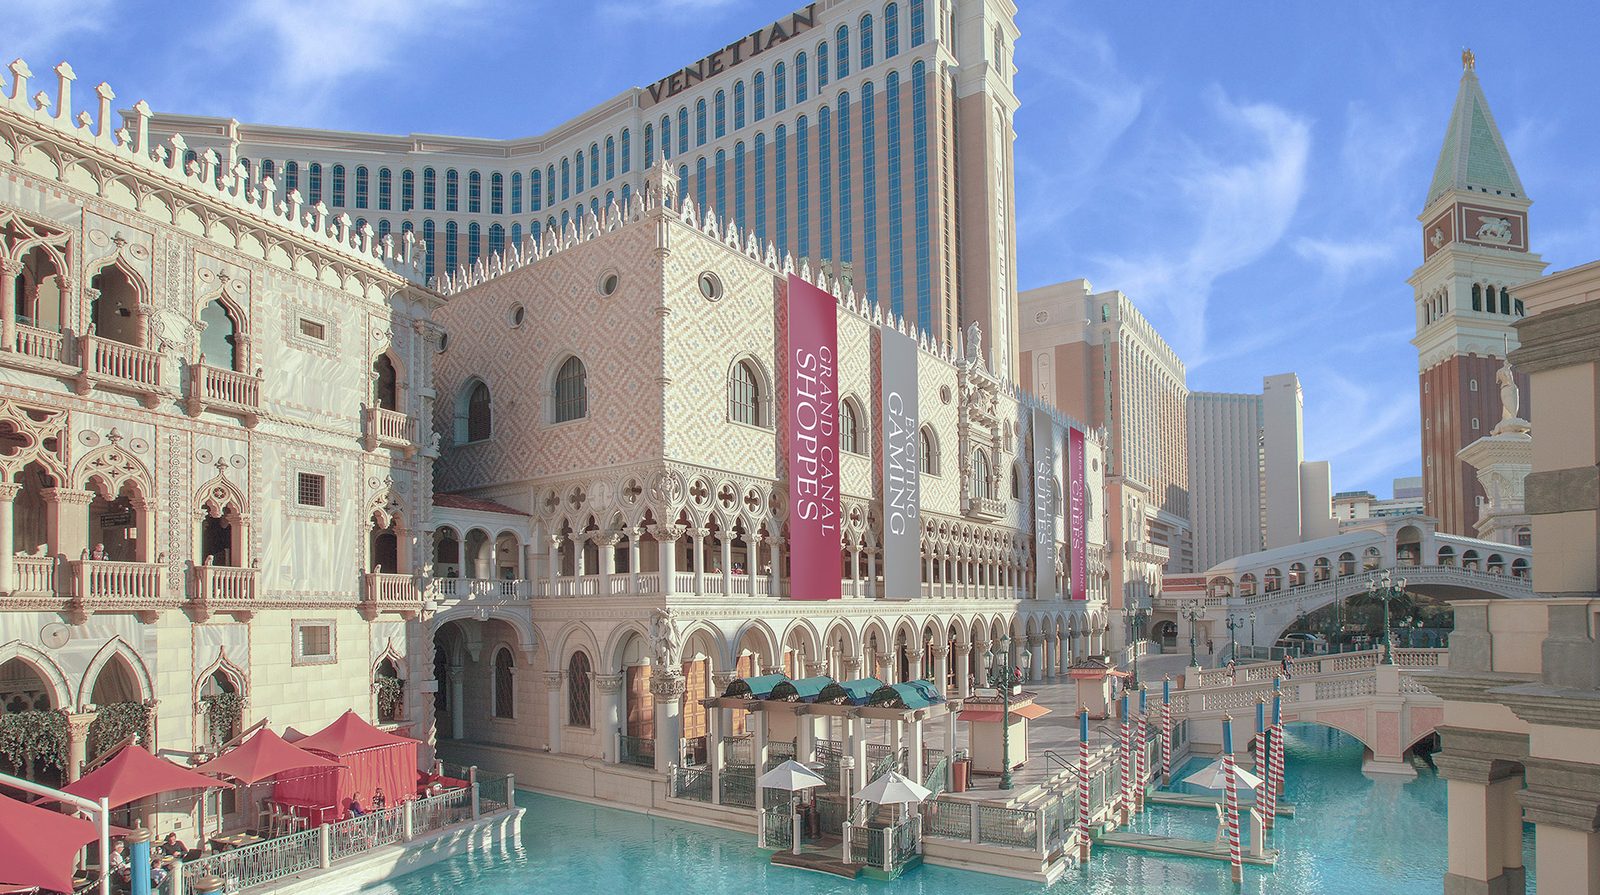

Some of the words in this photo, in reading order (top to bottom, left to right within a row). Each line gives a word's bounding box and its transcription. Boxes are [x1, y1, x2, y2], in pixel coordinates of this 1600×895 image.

[646, 3, 816, 104] VENETIAN
[796, 348, 819, 520] SHOPPES
[819, 345, 833, 436] GRAND
[820, 446, 835, 537] CANAL
[888, 392, 905, 535] GAMING
[905, 416, 916, 518] EXCITING
[1036, 460, 1047, 545] SUITES
[1072, 480, 1080, 549] CHEFS
